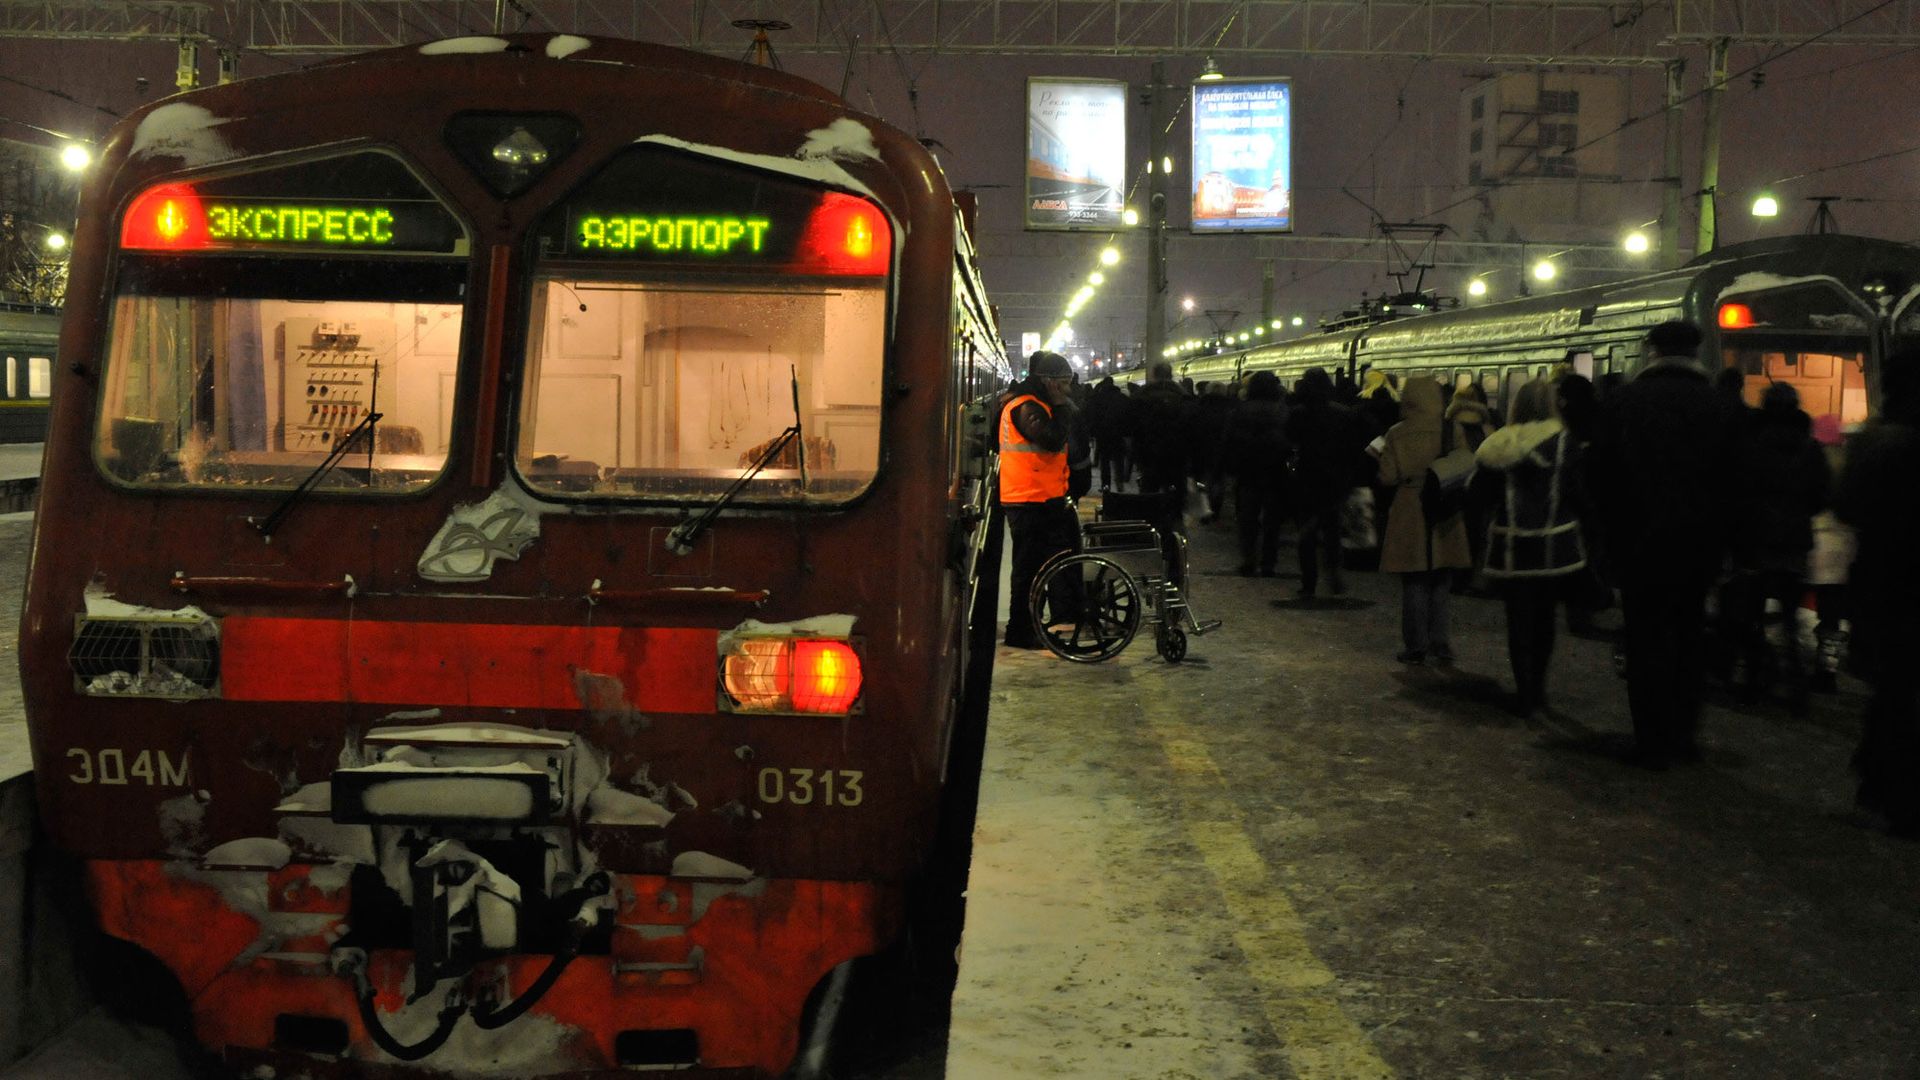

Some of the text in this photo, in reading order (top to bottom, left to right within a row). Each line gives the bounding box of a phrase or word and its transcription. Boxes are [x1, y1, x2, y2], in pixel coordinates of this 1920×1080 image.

[208, 206, 394, 242] ЭКСПРЕСС
[582, 217, 769, 252] АЭРОПОРТ
[66, 746, 192, 787] ЭД4М
[758, 767, 864, 807] 0313
